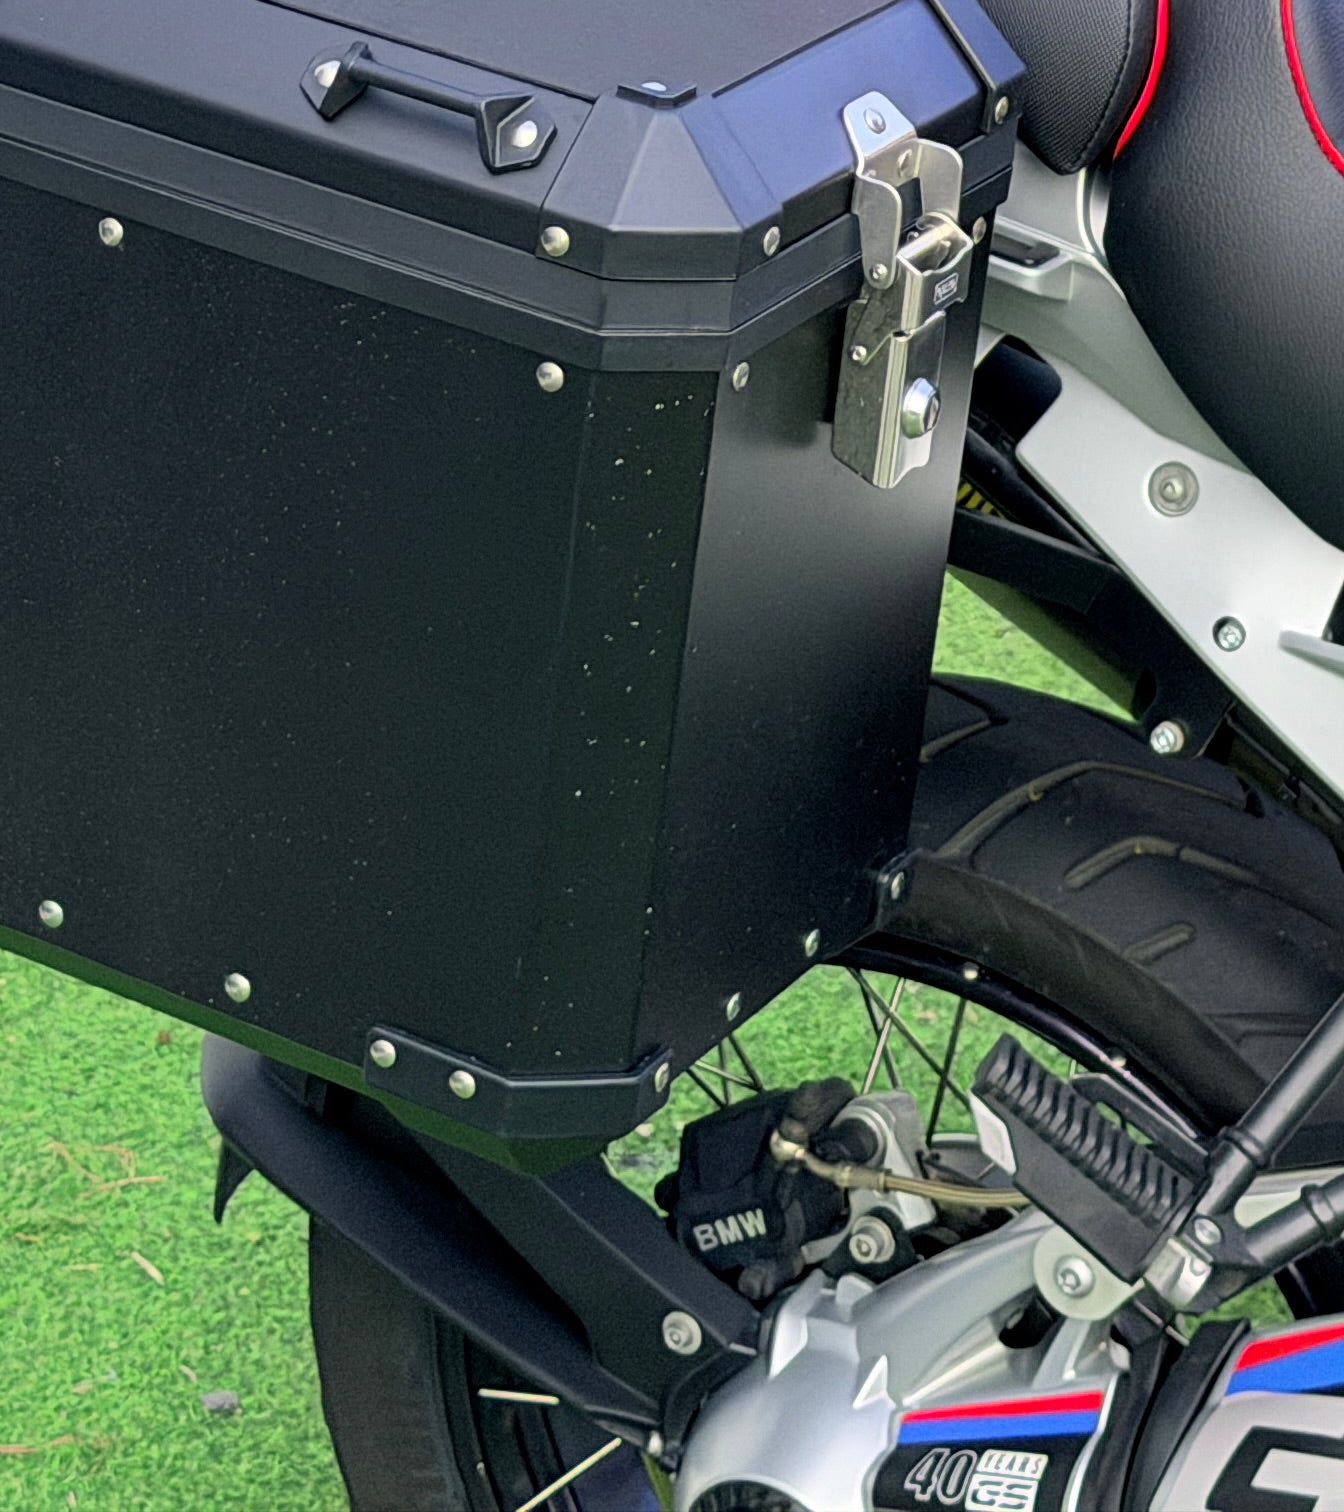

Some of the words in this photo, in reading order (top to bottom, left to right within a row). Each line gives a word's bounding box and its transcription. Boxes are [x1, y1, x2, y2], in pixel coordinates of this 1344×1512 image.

[693, 1207, 767, 1252] BMW
[903, 1447, 978, 1506] 40
[984, 1451, 1043, 1476] YEARS
[970, 1479, 1033, 1510] GS
